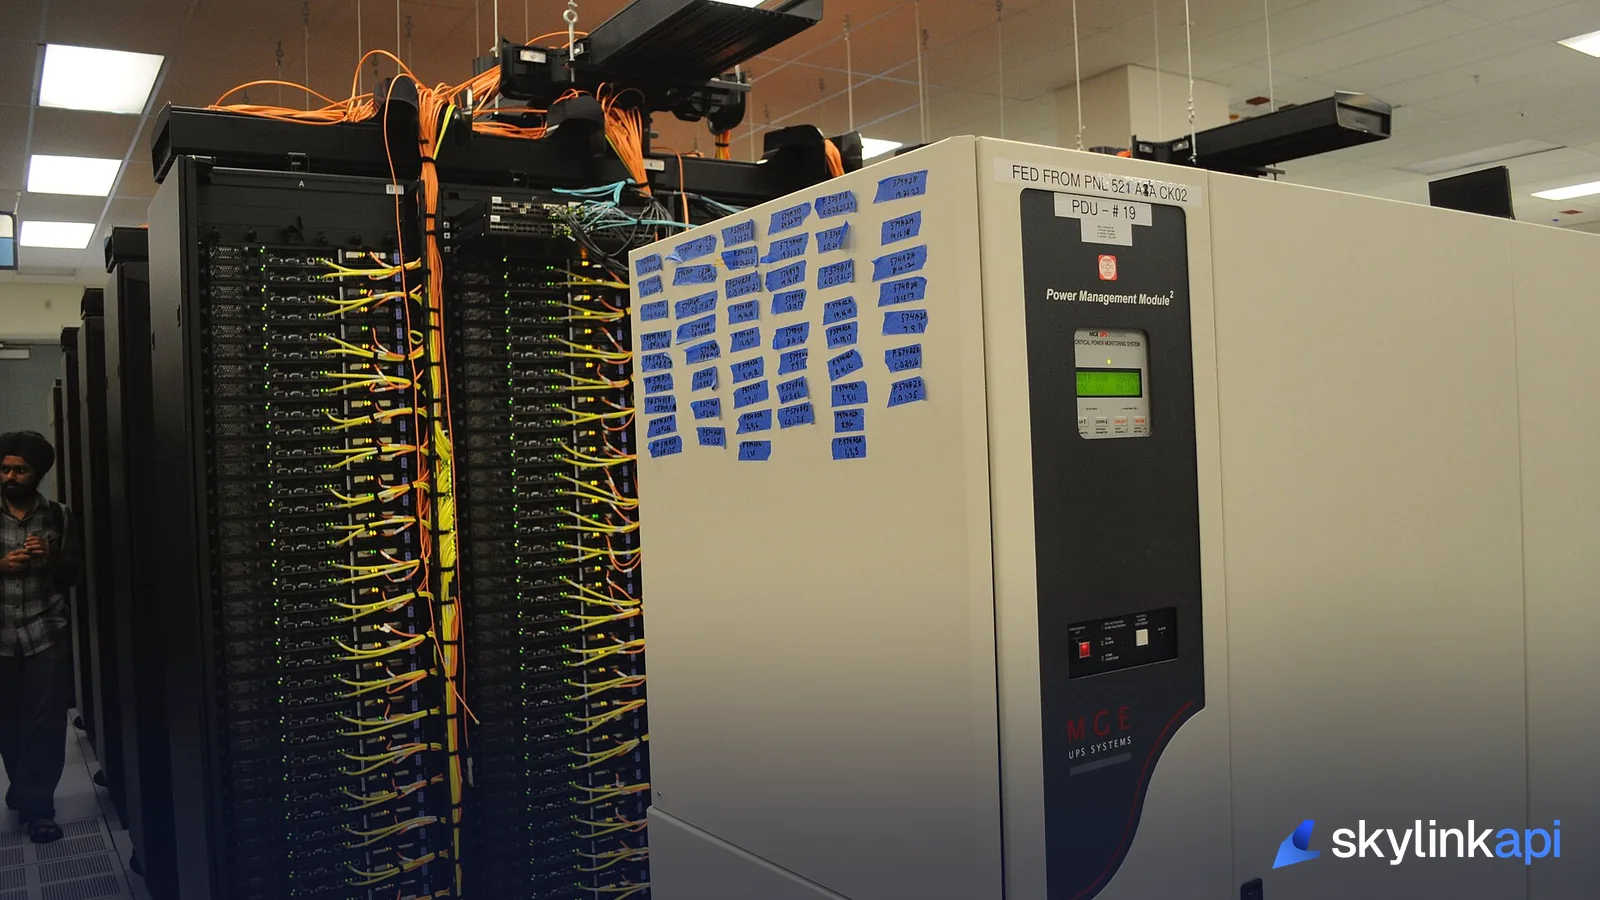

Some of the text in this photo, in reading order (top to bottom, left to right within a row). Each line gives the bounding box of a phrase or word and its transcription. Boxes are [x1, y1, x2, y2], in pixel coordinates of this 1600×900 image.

[1012, 164, 1039, 182] FED
[1044, 169, 1080, 188] FROM
[1084, 175, 1108, 191] PNL
[1112, 179, 1130, 194] 521
[1160, 186, 1187, 202] CK02
[1072, 200, 1098, 215] PDU
[1113, 204, 1118, 217] #
[1124, 206, 1136, 220] 19
[1046, 288, 1077, 301] Power
[1079, 290, 1137, 305] Management
[1066, 704, 1131, 744] MGE
[1068, 735, 1132, 760] UPS SYSTEMS
